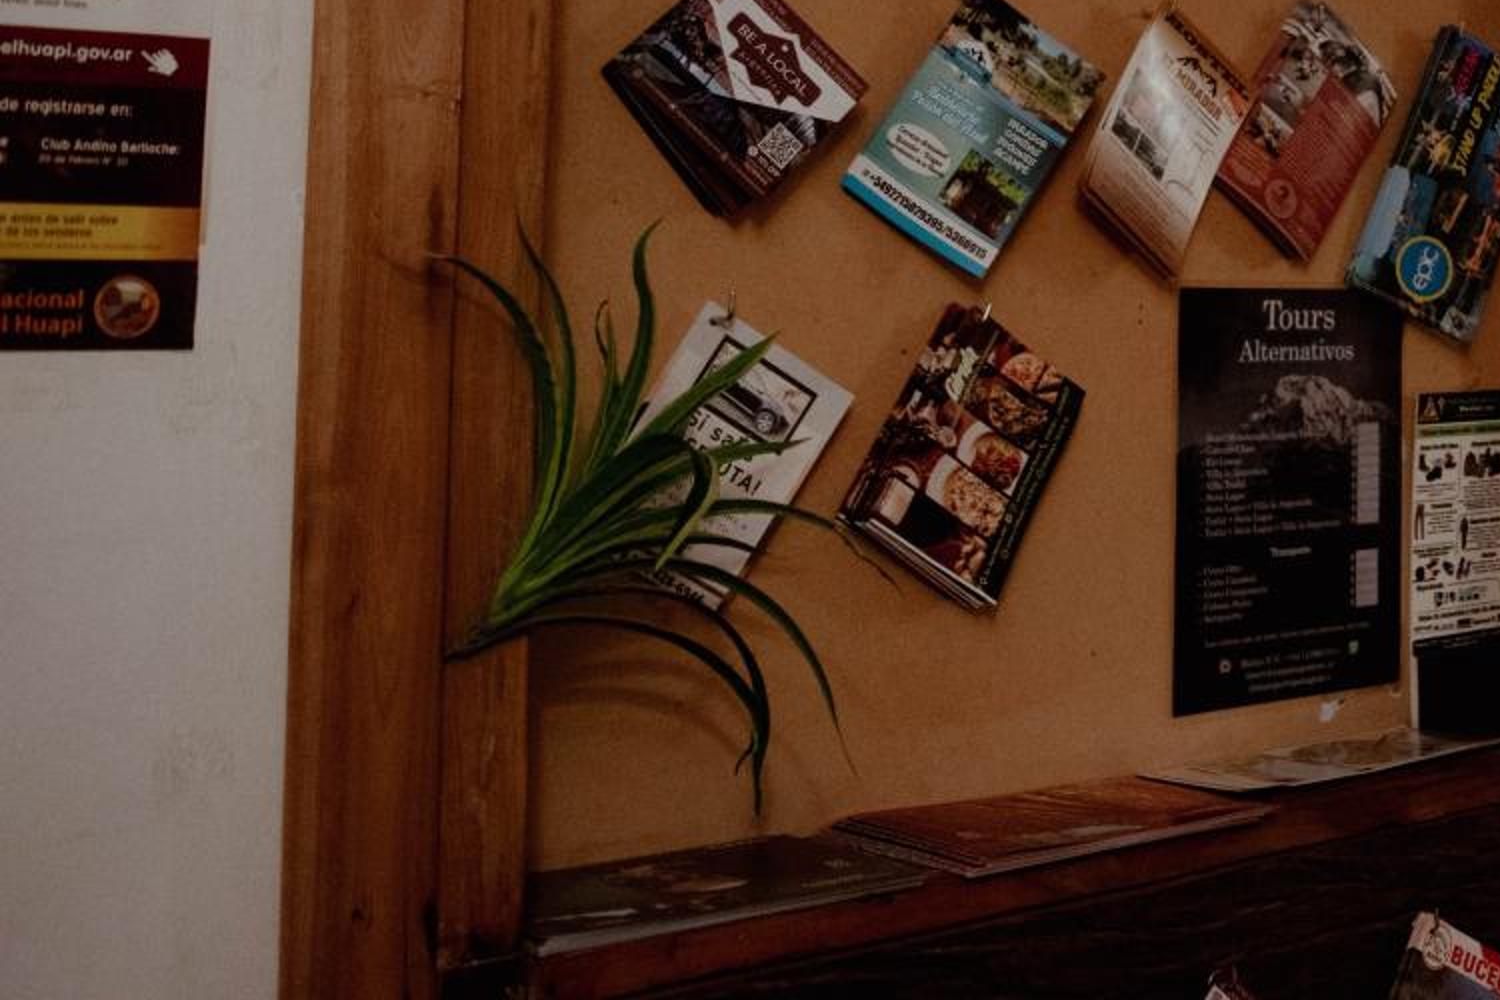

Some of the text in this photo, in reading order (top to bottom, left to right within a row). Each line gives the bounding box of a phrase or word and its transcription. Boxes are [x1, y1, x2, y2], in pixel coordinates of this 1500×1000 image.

[0, 40, 133, 63] elhuapi.gov.ar
[736, 22, 758, 44] BE
[753, 42, 768, 55] A
[766, 53, 808, 94] LOCAL
[25, 100, 104, 118] registrarse
[40, 137, 71, 151] Club
[73, 138, 117, 152] Andino
[13, 313, 84, 337] Huapi
[1263, 299, 1337, 332] Tours
[1237, 336, 1356, 363] Alternativos
